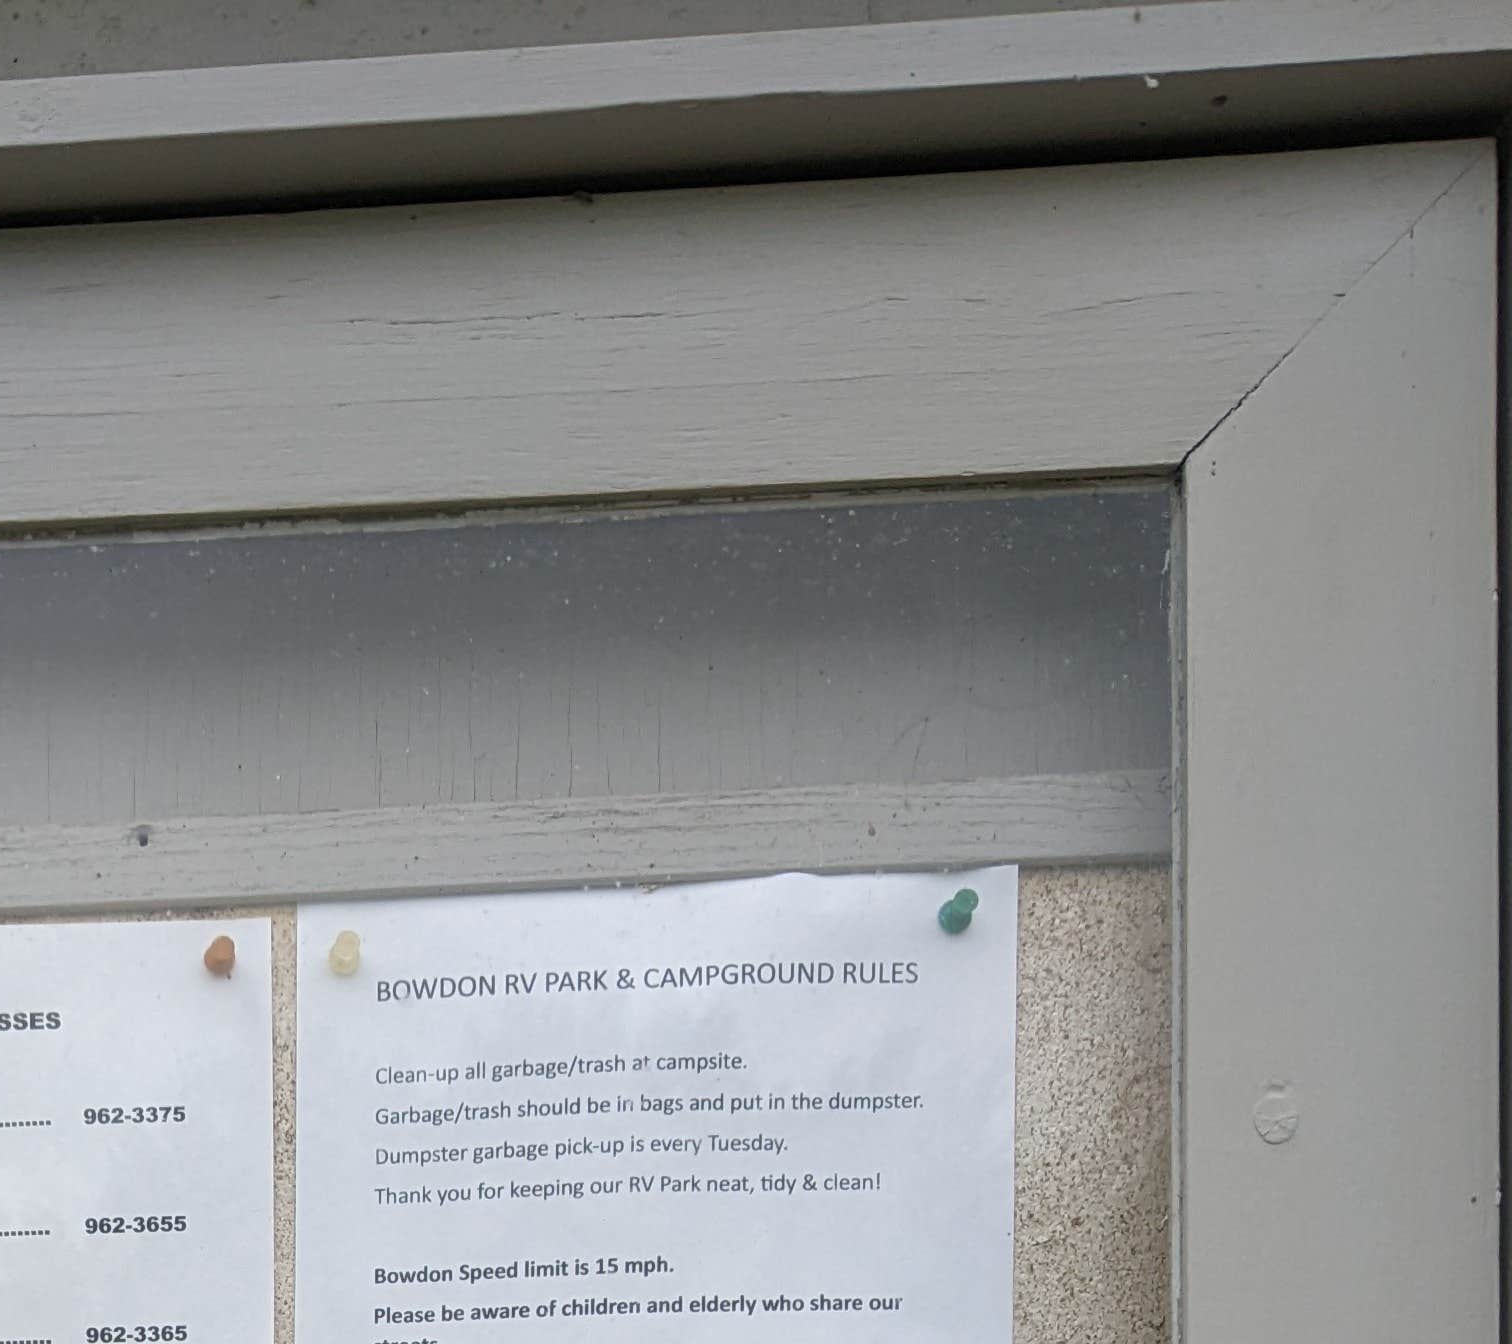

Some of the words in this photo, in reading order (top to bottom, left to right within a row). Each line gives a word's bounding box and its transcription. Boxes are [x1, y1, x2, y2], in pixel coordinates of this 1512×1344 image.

[377, 974, 495, 1002] BOWDON
[505, 972, 537, 995] RV
[545, 969, 607, 993] PARK
[616, 968, 635, 989] &
[643, 961, 834, 988] CAMPGROUND
[843, 961, 918, 984] RULES
[375, 1066, 458, 1085] Clean-up
[464, 1060, 485, 1080] all
[491, 1053, 625, 1082] garbage/trash
[632, 1055, 650, 1071] at
[656, 1051, 747, 1074] campsite.
[374, 1265, 452, 1284] Bowdon
[459, 1260, 518, 1284] Speed
[524, 1259, 568, 1278] limit
[574, 1258, 589, 1276] is
[595, 1257, 618, 1274] 15
[624, 1255, 674, 1277] mph.
